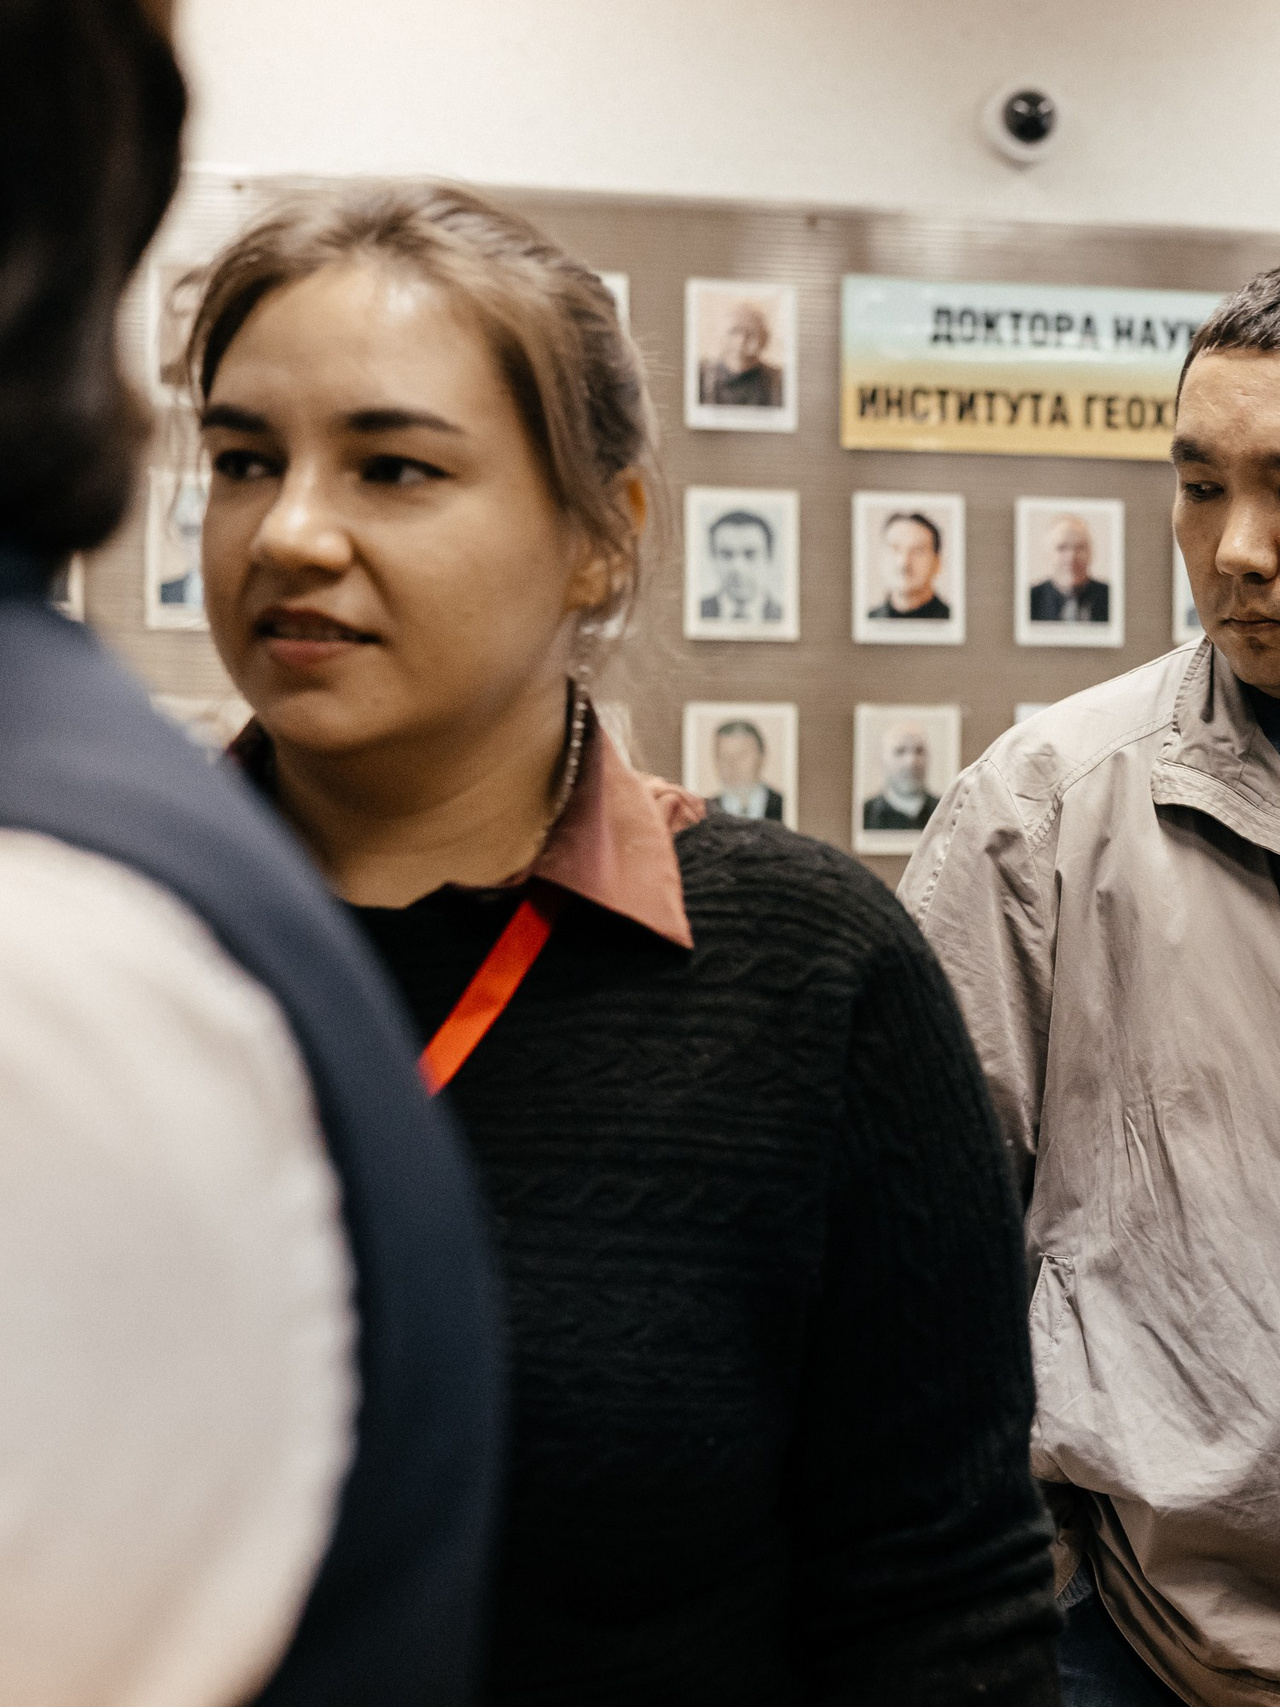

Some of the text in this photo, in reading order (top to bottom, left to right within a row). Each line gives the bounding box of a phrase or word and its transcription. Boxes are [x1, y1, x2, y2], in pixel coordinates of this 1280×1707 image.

[930, 306, 1099, 349] ДОКТОРА
[858, 384, 1176, 430] ИНСТИТУТА ГЕОХ
